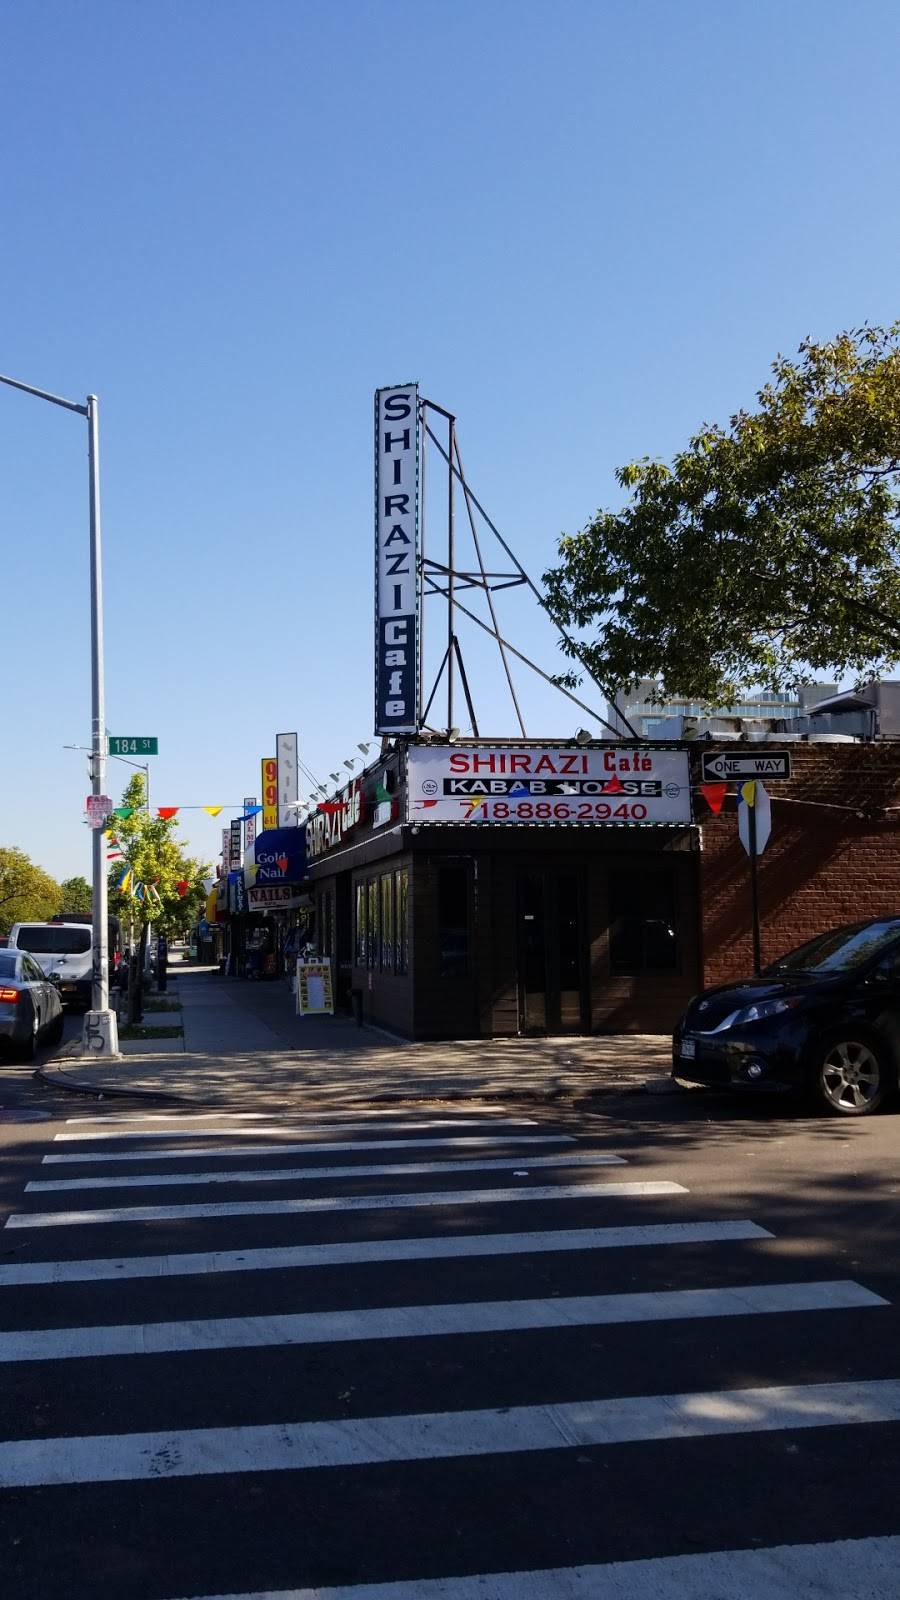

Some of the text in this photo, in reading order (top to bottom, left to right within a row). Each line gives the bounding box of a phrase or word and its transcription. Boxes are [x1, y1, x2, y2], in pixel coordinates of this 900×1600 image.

[384, 394, 412, 611] SHIRAZI
[384, 620, 407, 717] Cafe
[115, 739, 151, 753] 184 St
[449, 751, 652, 774] SHIRAZI Café
[714, 760, 782, 772] ONE WAY
[450, 779, 547, 794] KABAB
[459, 802, 648, 820] 718-886-2940
[250, 887, 290, 903] NAILS
